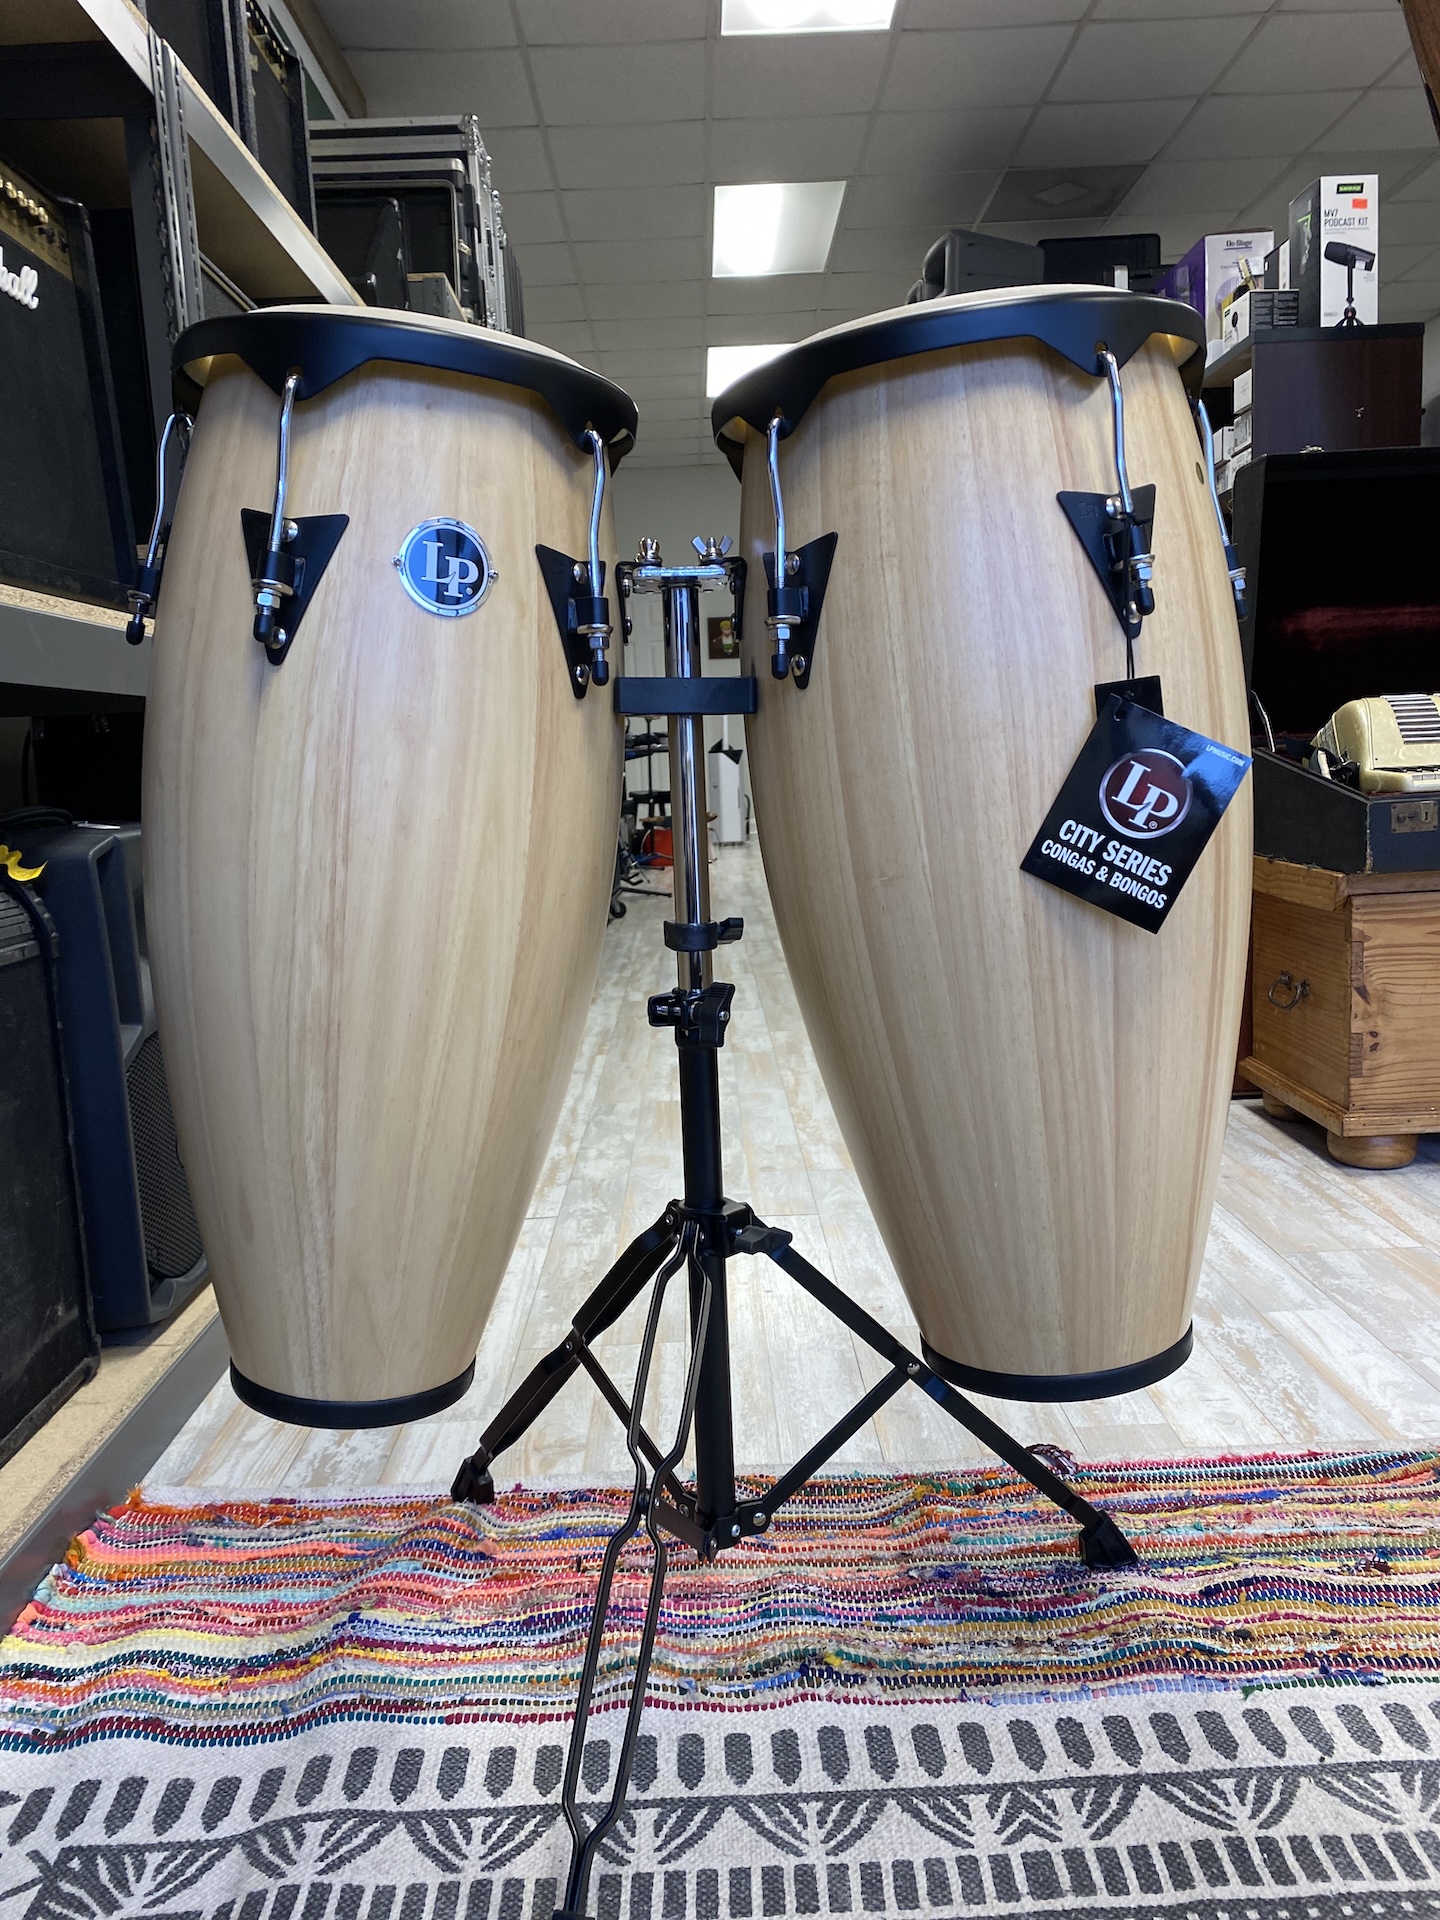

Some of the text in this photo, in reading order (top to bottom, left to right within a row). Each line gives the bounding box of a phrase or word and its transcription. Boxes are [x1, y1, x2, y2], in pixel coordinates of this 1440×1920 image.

[1324, 208, 1338, 218] MV7
[1324, 217, 1368, 227] PODCAST KIT
[1205, 744, 1245, 767] LPMUSIC.COM
[1059, 819, 1173, 887] CITY SERIES
[1041, 839, 1168, 910] CONGAS & BONGOS
